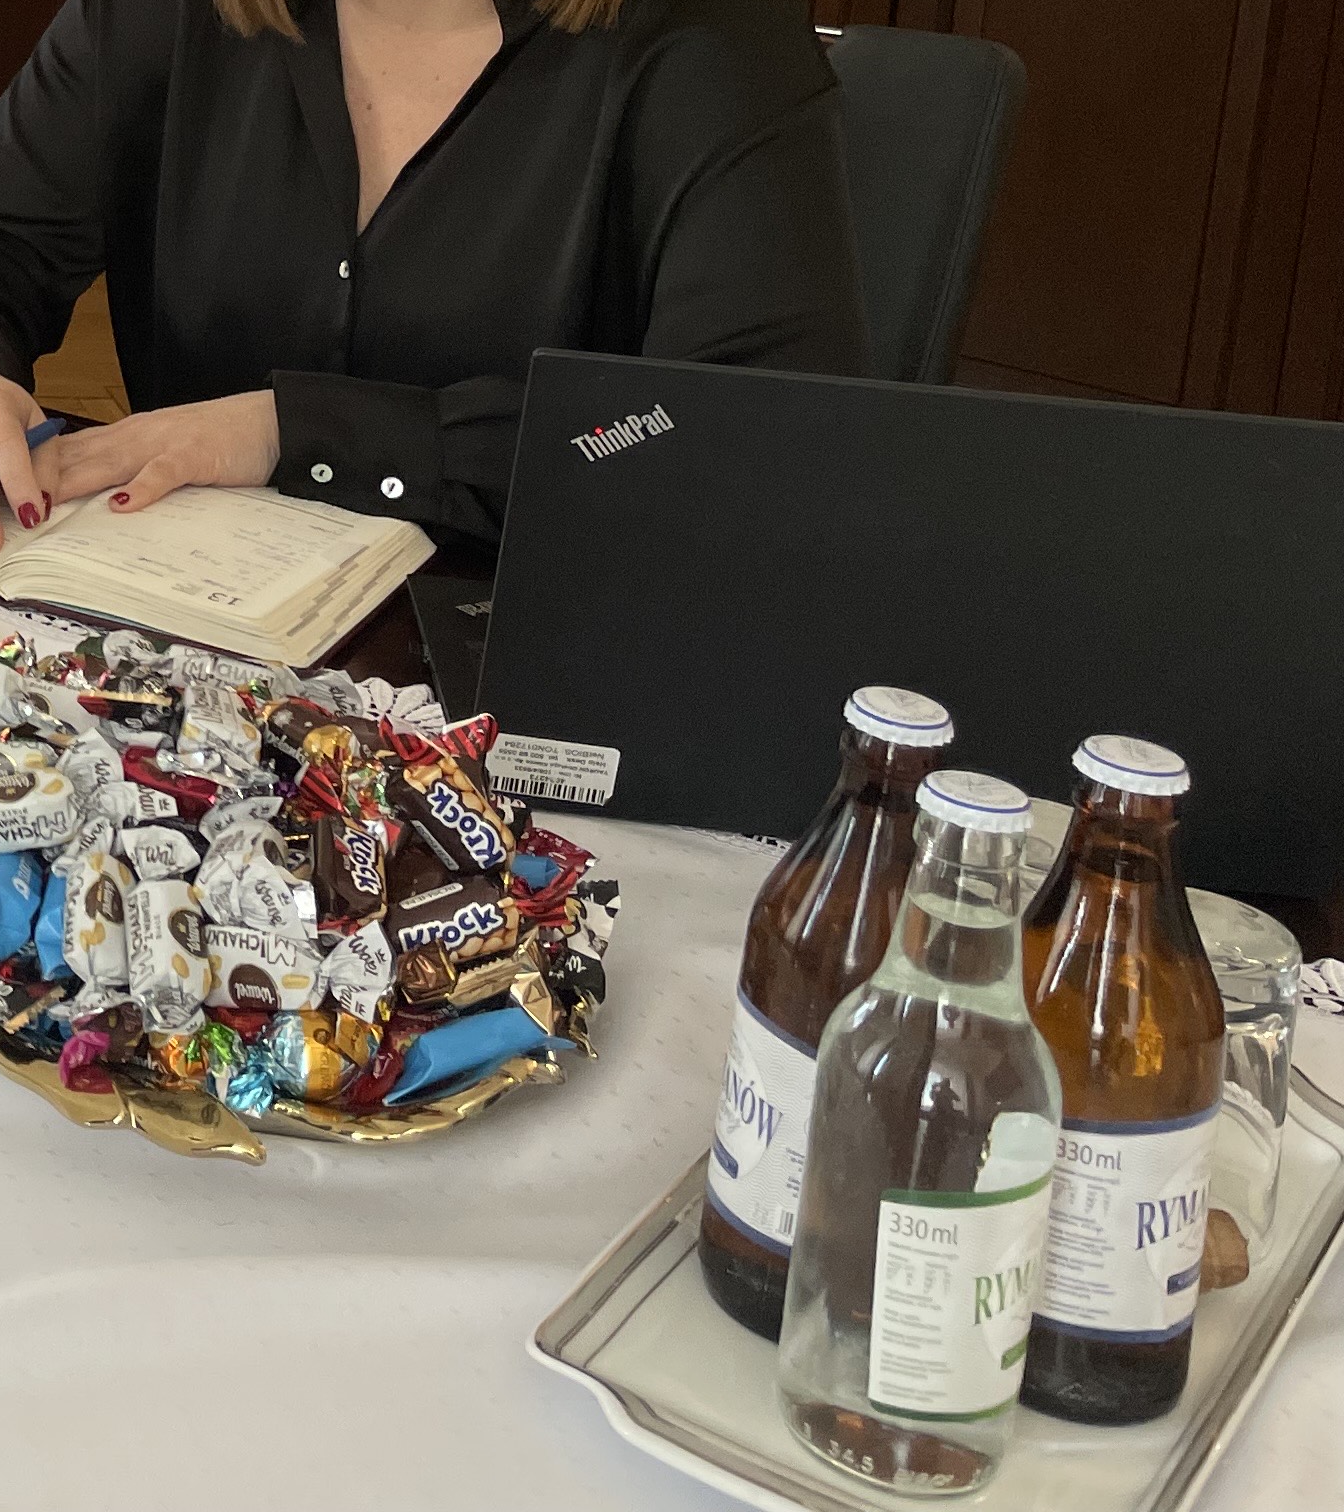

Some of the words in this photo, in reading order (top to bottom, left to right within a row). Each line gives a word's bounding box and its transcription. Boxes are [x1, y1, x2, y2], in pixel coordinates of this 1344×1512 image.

[570, 403, 675, 462] ThinkPad
[207, 592, 244, 606] 13
[427, 781, 506, 869] Krock
[345, 826, 382, 895] Krock
[401, 903, 503, 951] Krock
[234, 982, 276, 1005] Wawel
[1136, 1182, 1209, 1251] RYM
